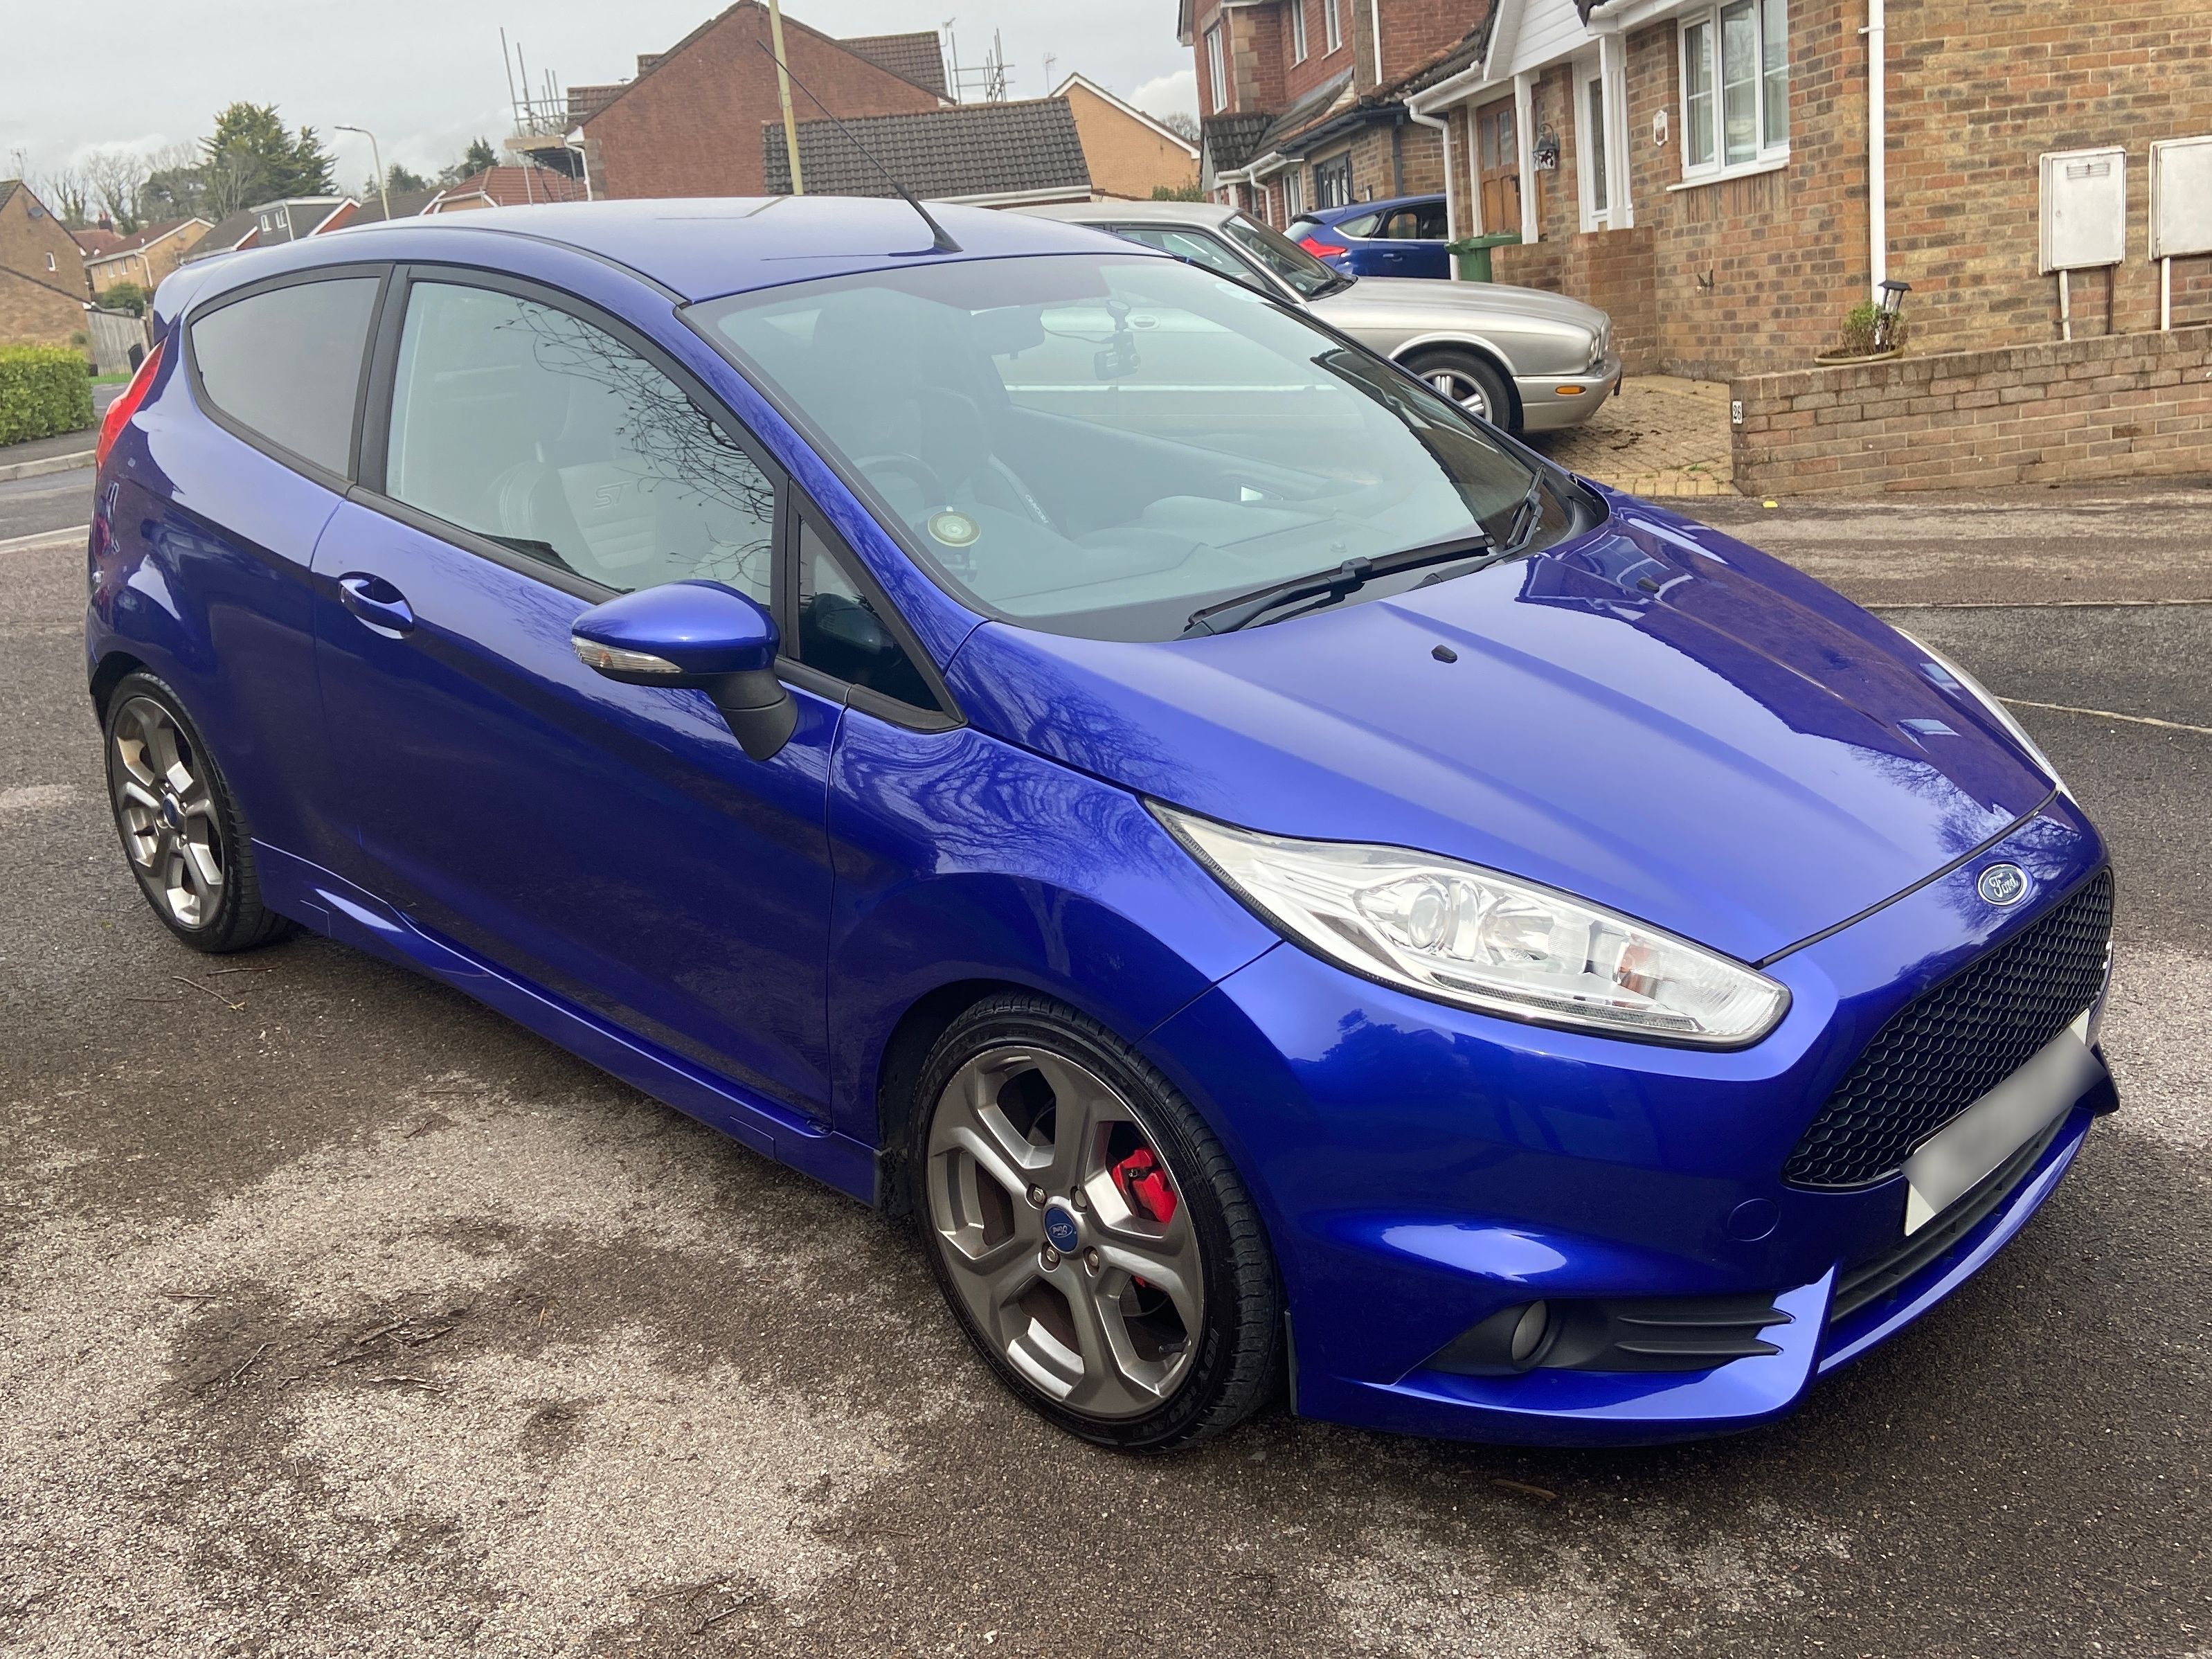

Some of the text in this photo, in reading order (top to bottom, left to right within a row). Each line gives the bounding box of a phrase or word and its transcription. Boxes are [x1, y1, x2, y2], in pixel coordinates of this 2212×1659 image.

[1733, 404, 1741, 421] 26
[593, 481, 632, 510] ST
[1988, 872, 2019, 898] Ford
[1052, 1224, 1068, 1236] Ford
